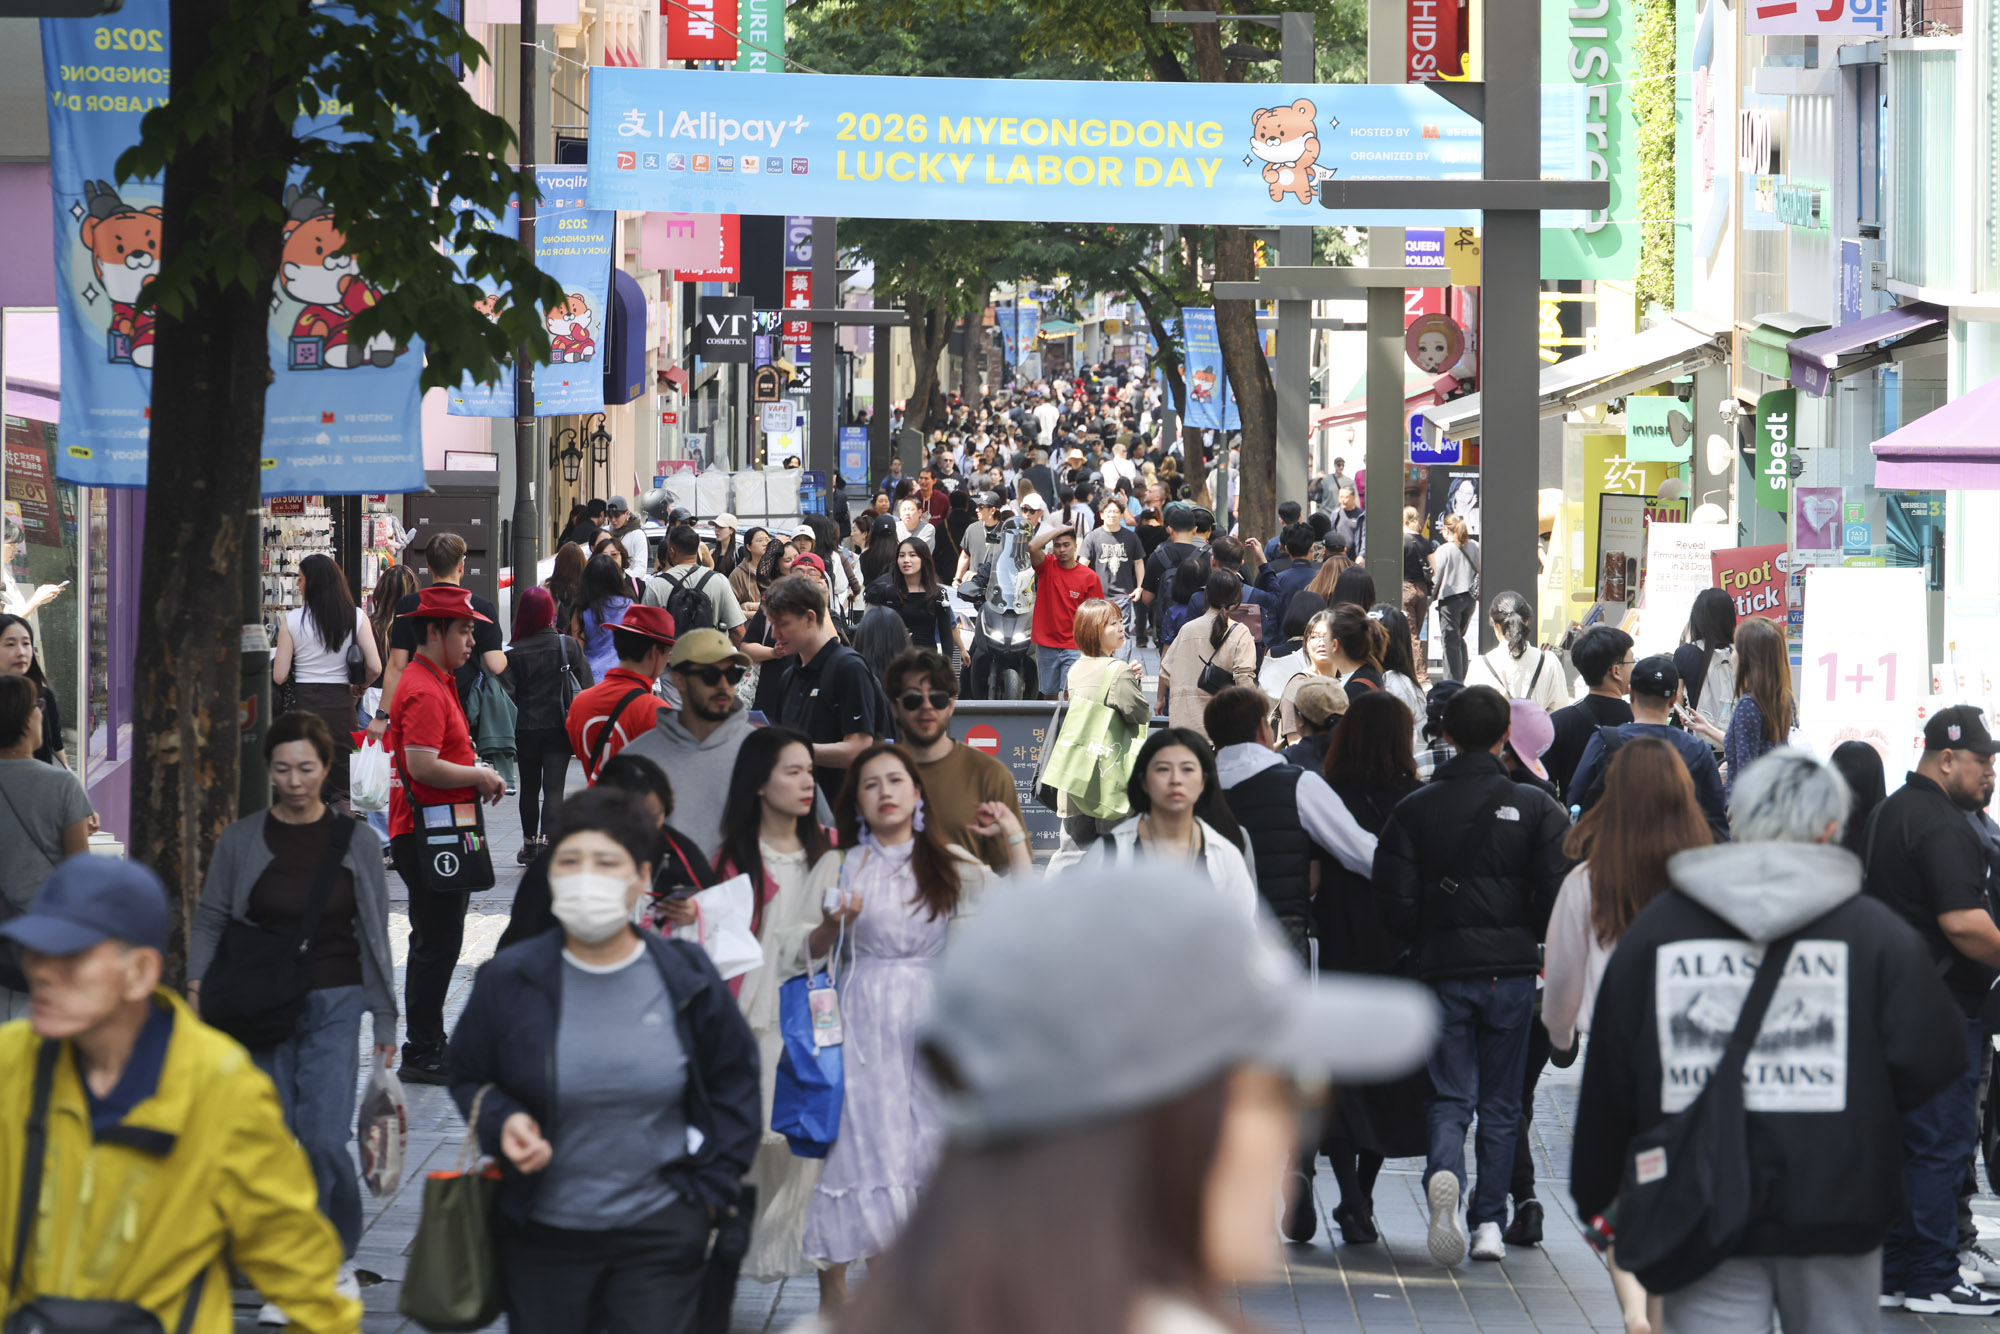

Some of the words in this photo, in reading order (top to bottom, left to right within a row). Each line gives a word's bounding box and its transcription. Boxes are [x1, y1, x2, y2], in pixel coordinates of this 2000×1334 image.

[836, 112, 928, 143] 2026
[938, 115, 1224, 149] MYEONGDONG
[1350, 128, 1394, 137] HOSTED
[1395, 128, 1410, 137] BY
[1350, 151, 1414, 161] ORGANIZED
[1416, 151, 1430, 161] BY
[836, 150, 975, 184] LUCKY
[985, 153, 1123, 187] LABOR
[1135, 156, 1223, 188] DAY
[1405, 240, 1441, 252] QUEEN
[706, 314, 747, 336] VT
[706, 337, 747, 346] COSMETICS
[788, 386, 811, 394] CONV
[769, 405, 788, 413] VAPE
[1610, 516, 1633, 525] HAIR
[1676, 540, 1706, 550] Reveal
[1653, 551, 1686, 560] Firmness
[1671, 562, 1679, 571] in
[1680, 562, 1690, 571] 28
[1691, 562, 1711, 573] Days
[1719, 560, 1772, 591] Foot
[1731, 585, 1780, 616] tick
[1791, 614, 1803, 622] VIS
[1817, 651, 1898, 702] 1+1
[1012, 745, 1026, 760] 차
[1087, 740, 1114, 759] NET
[1669, 952, 1836, 977] ALASAN
[1669, 1064, 1835, 1085] MOTAINS
